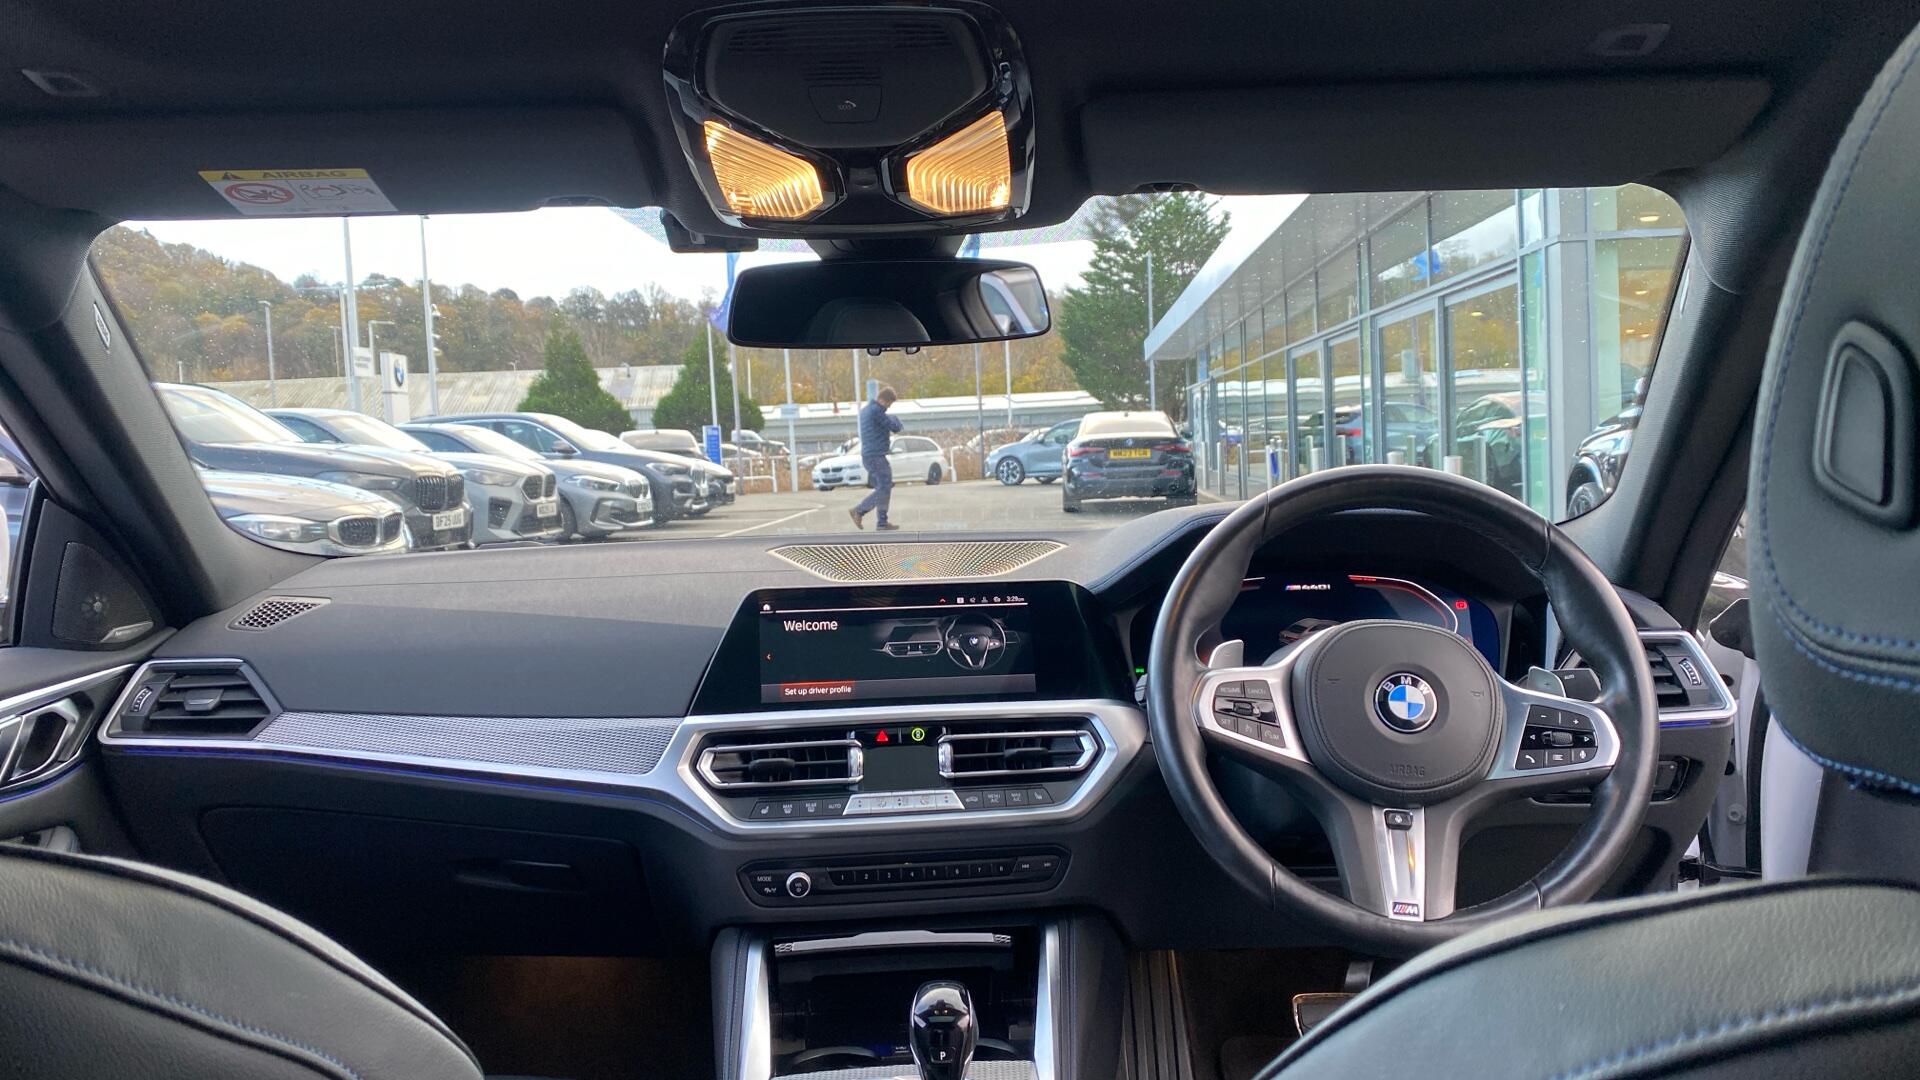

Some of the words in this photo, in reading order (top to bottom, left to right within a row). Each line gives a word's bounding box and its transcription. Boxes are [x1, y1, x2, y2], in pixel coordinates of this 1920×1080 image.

[261, 170, 346, 178] AIRBAG
[783, 620, 838, 631] Welcome
[784, 688, 797, 696] Set
[798, 688, 807, 696] up
[808, 686, 828, 694] driver
[829, 685, 852, 694] profile
[1382, 675, 1431, 696] BMW
[940, 1051, 946, 1060] P
